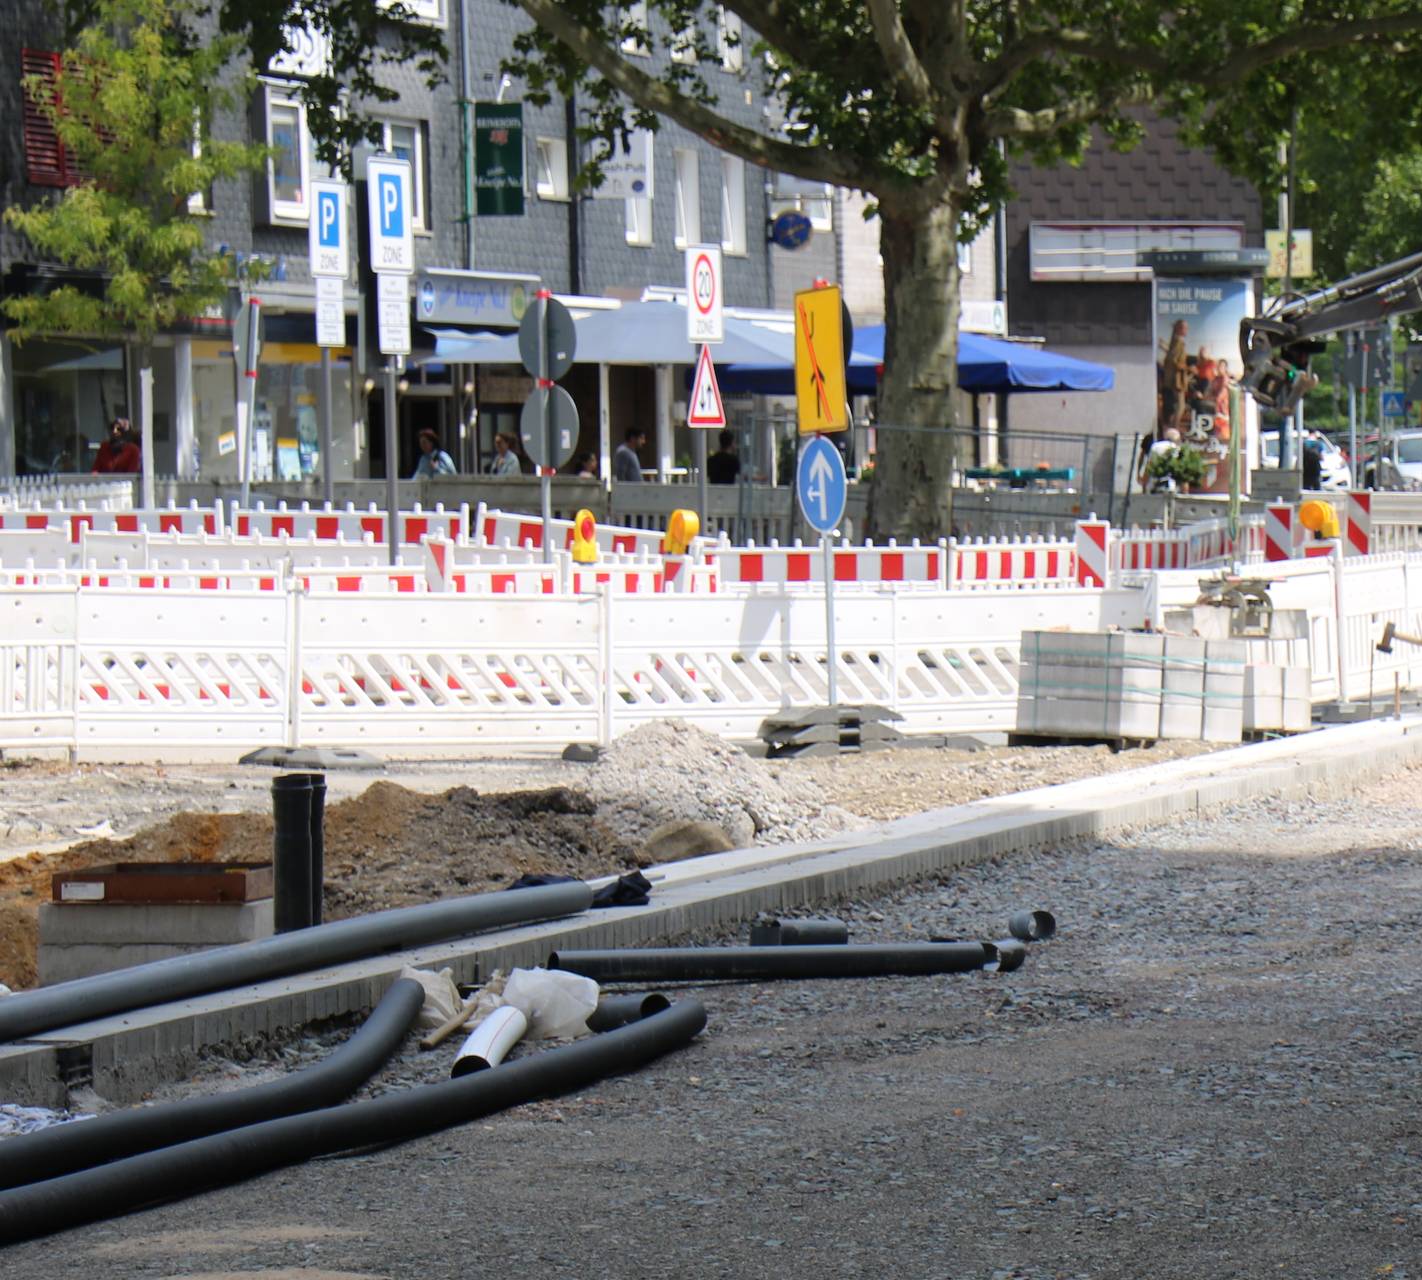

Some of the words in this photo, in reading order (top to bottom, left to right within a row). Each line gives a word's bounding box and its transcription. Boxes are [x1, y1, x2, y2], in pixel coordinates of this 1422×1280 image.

[383, 181, 398, 229] P
[322, 197, 335, 240] P
[320, 254, 339, 270] ZONE
[383, 246, 403, 264] ZONE
[698, 271, 711, 298] 20
[1194, 287, 1223, 301] PAUSE
[696, 318, 714, 335] ZONE
